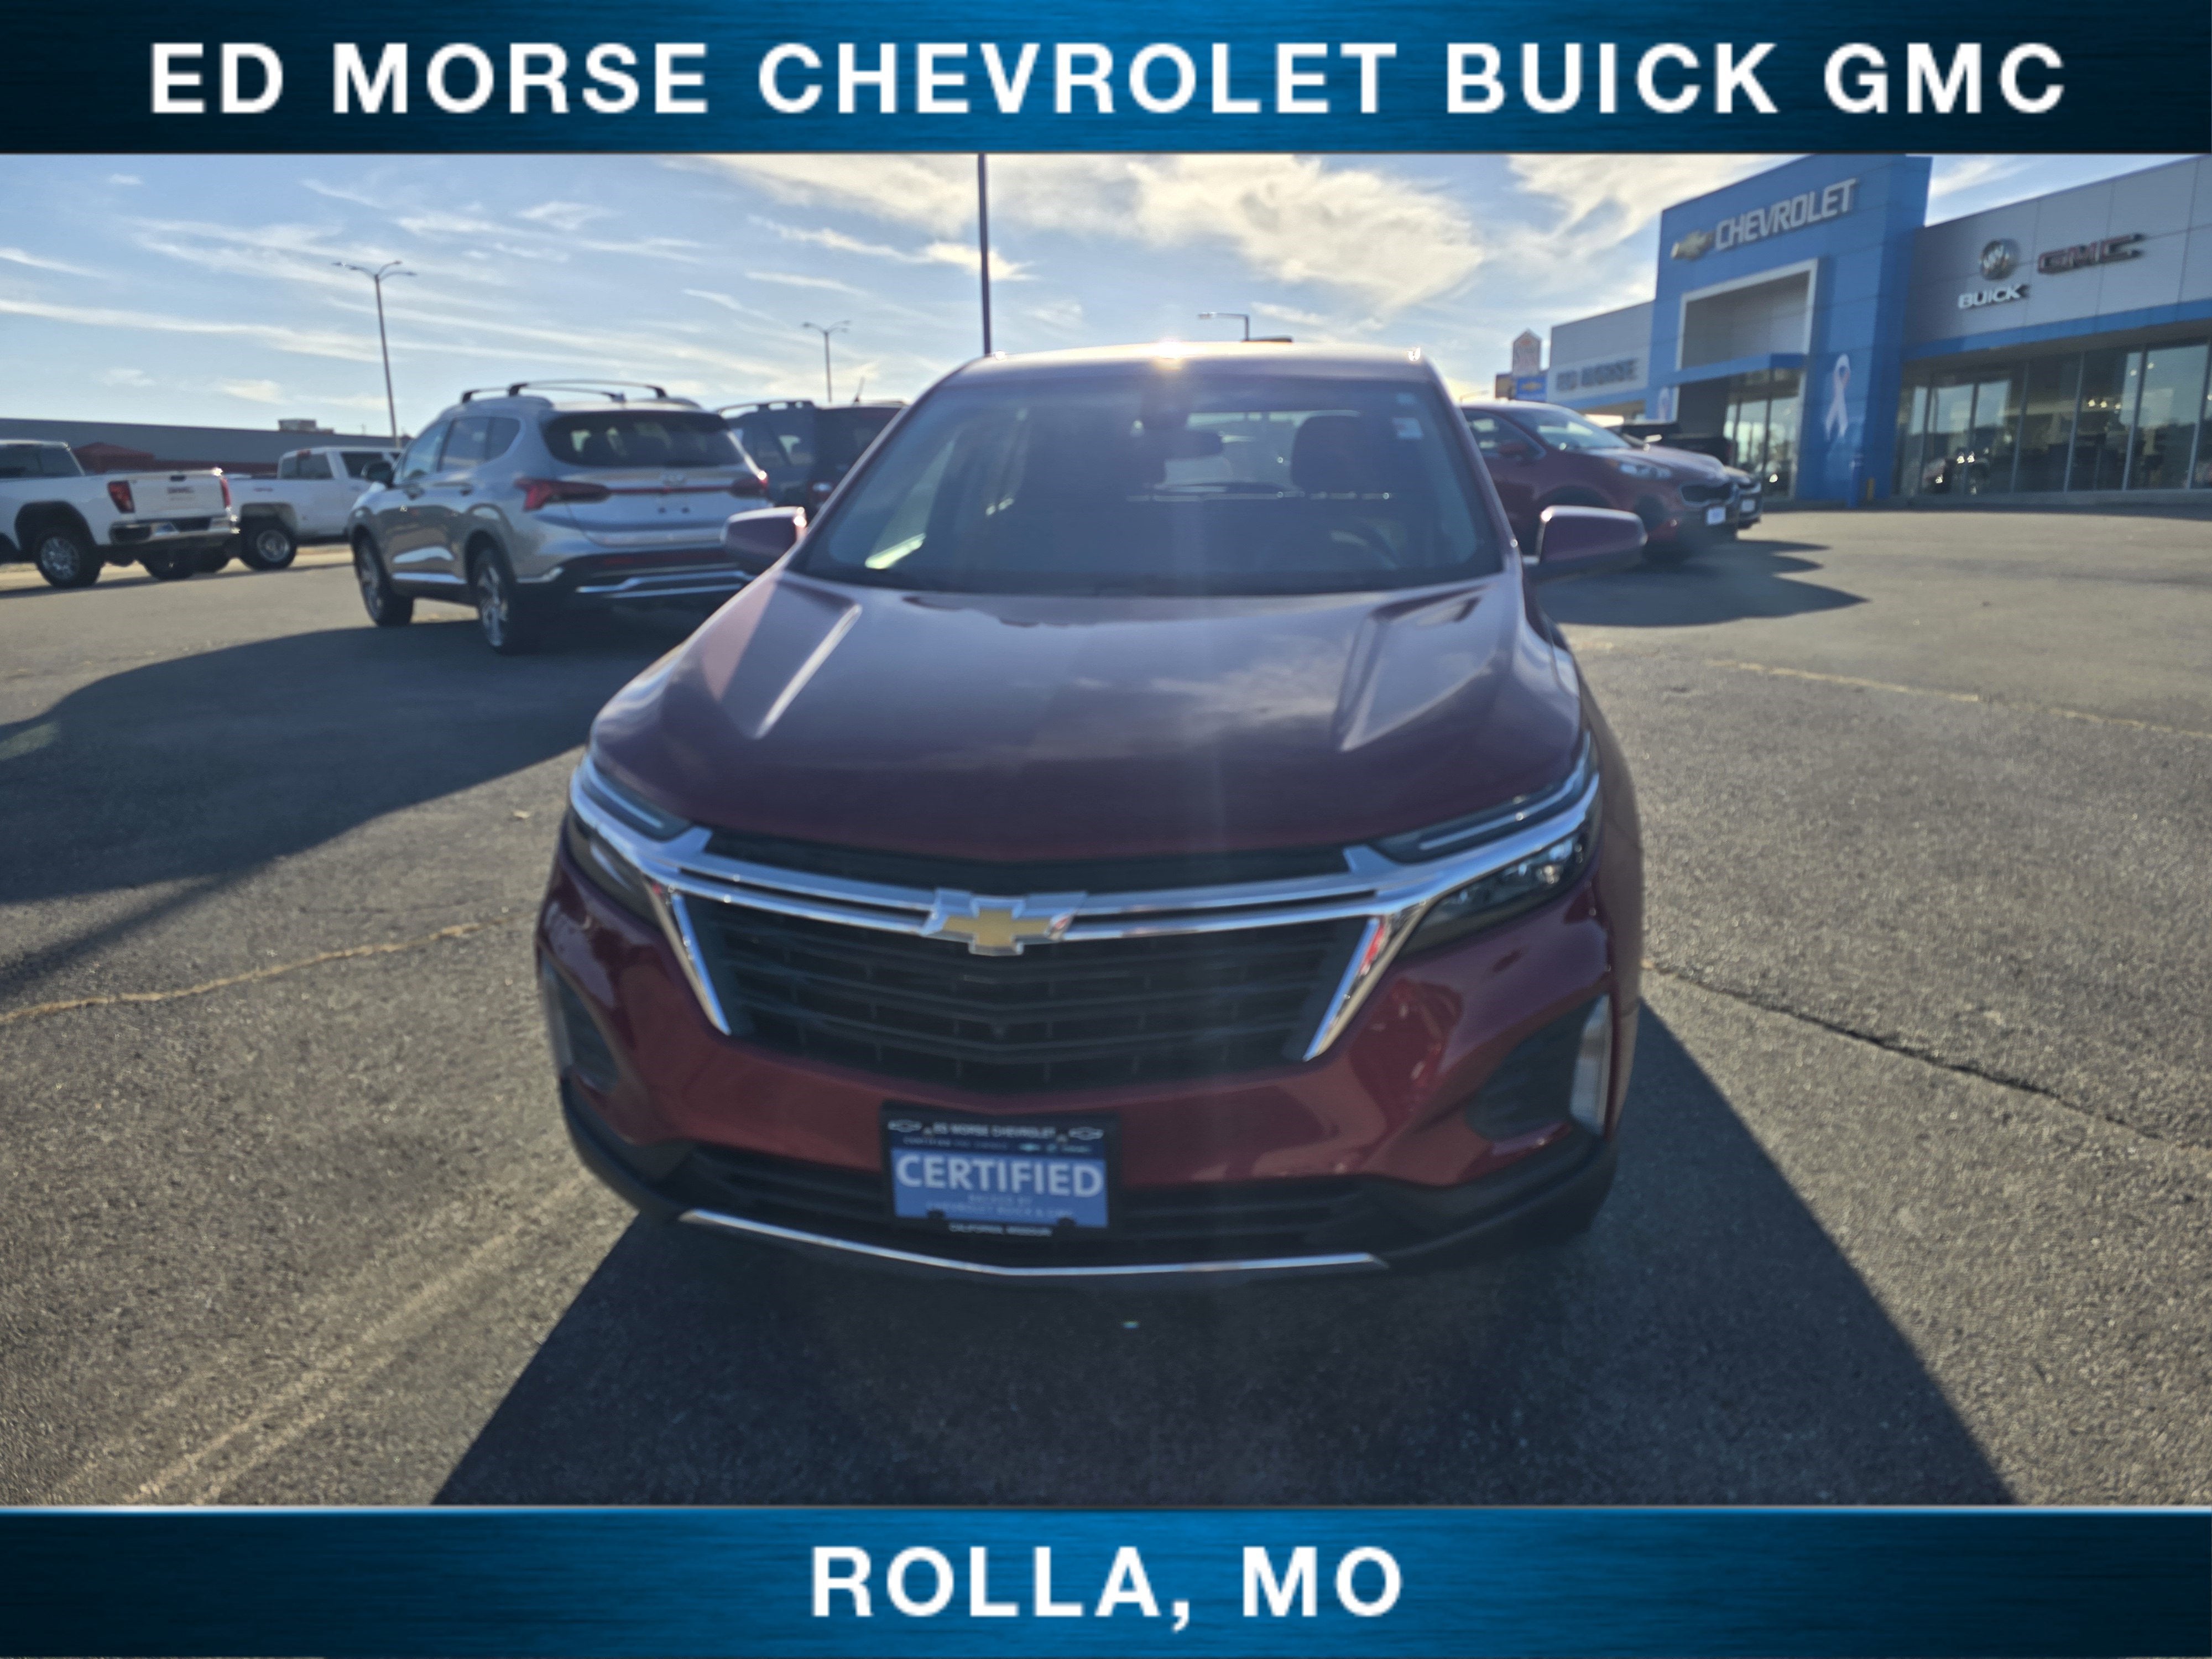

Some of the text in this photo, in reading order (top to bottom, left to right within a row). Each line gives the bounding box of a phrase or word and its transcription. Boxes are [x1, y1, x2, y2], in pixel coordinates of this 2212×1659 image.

[1716, 178, 1858, 252] CHEVROLET
[2037, 234, 2142, 275] GMC
[1958, 284, 2024, 310] BUICK
[895, 1153, 1104, 1199] CERTIFIED
